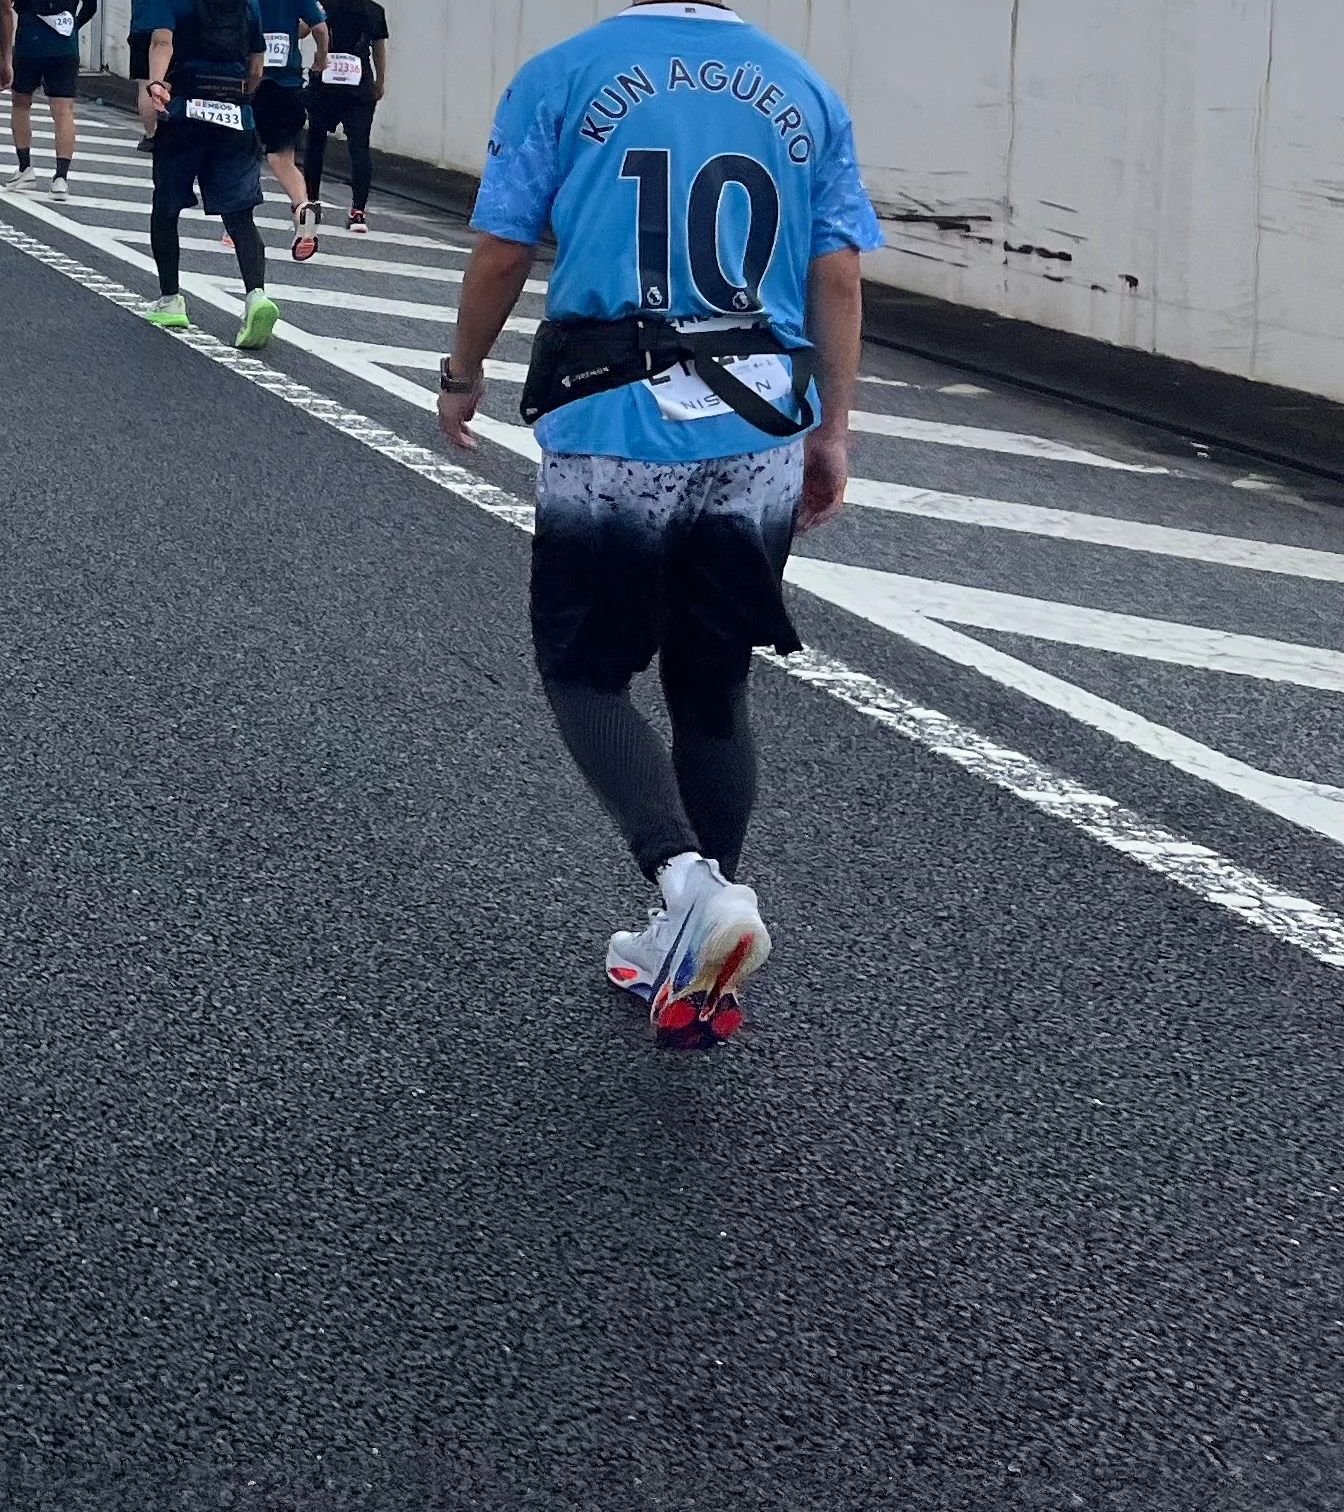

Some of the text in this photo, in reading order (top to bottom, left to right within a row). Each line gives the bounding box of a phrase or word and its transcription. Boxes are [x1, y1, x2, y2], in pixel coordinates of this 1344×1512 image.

[579, 63, 657, 144] KUN
[667, 54, 815, 164] AGÜERO
[618, 147, 780, 315] 10
